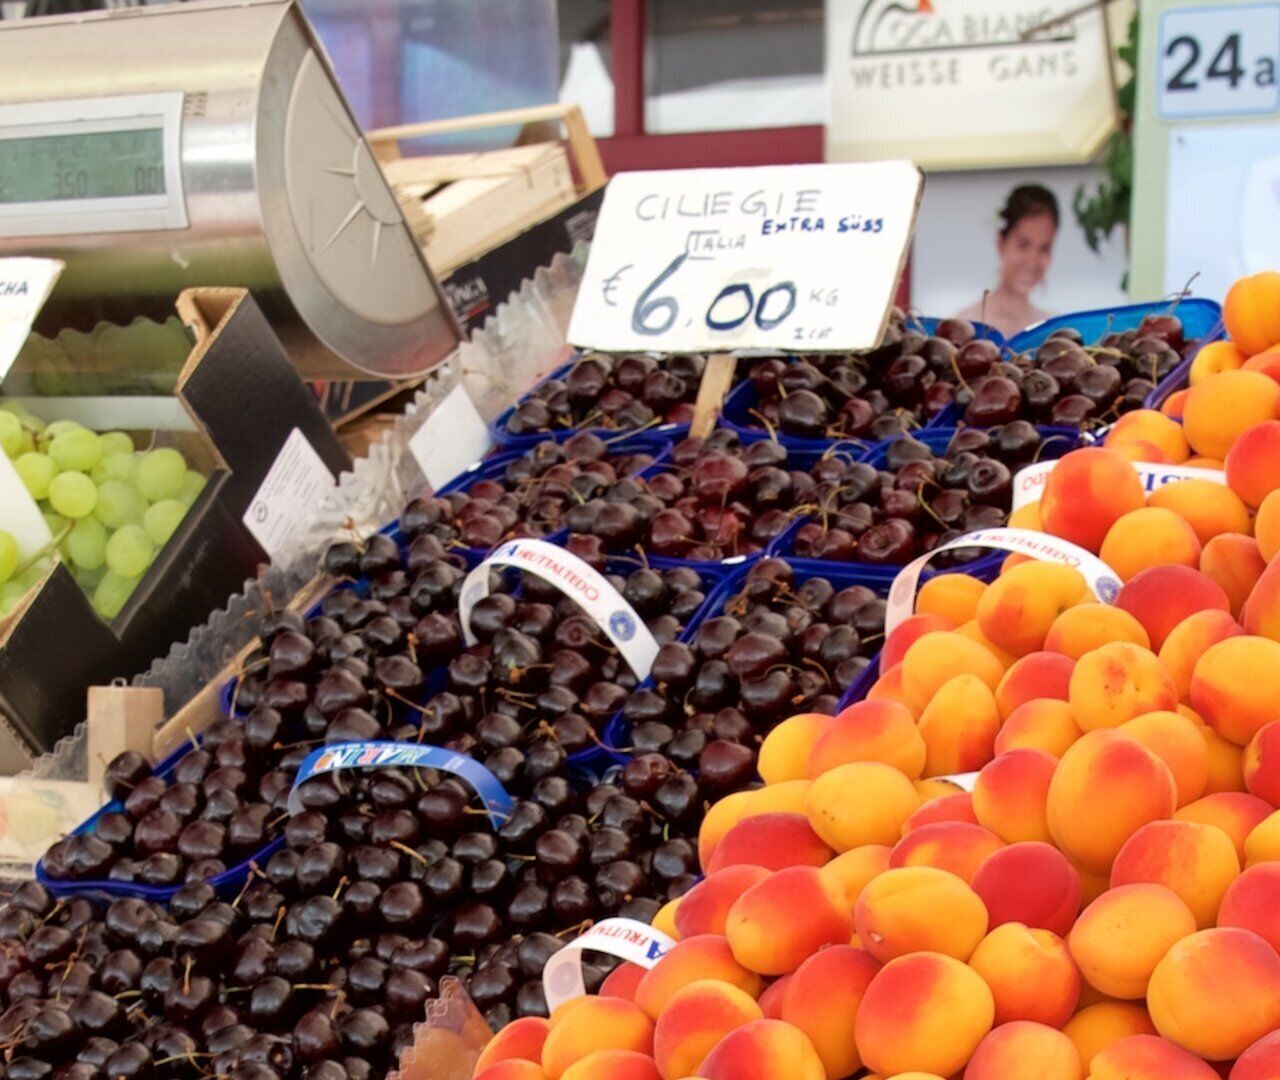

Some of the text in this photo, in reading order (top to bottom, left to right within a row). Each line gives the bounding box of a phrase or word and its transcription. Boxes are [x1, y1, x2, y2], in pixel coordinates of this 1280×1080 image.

[852, 51, 1078, 88] WEISSE GANS
[636, 188, 821, 221] CILIEGIE
[761, 217, 825, 235] EXTRA
[687, 230, 746, 260] ITALIA
[602, 265, 634, 306] €
[810, 289, 839, 306] KG
